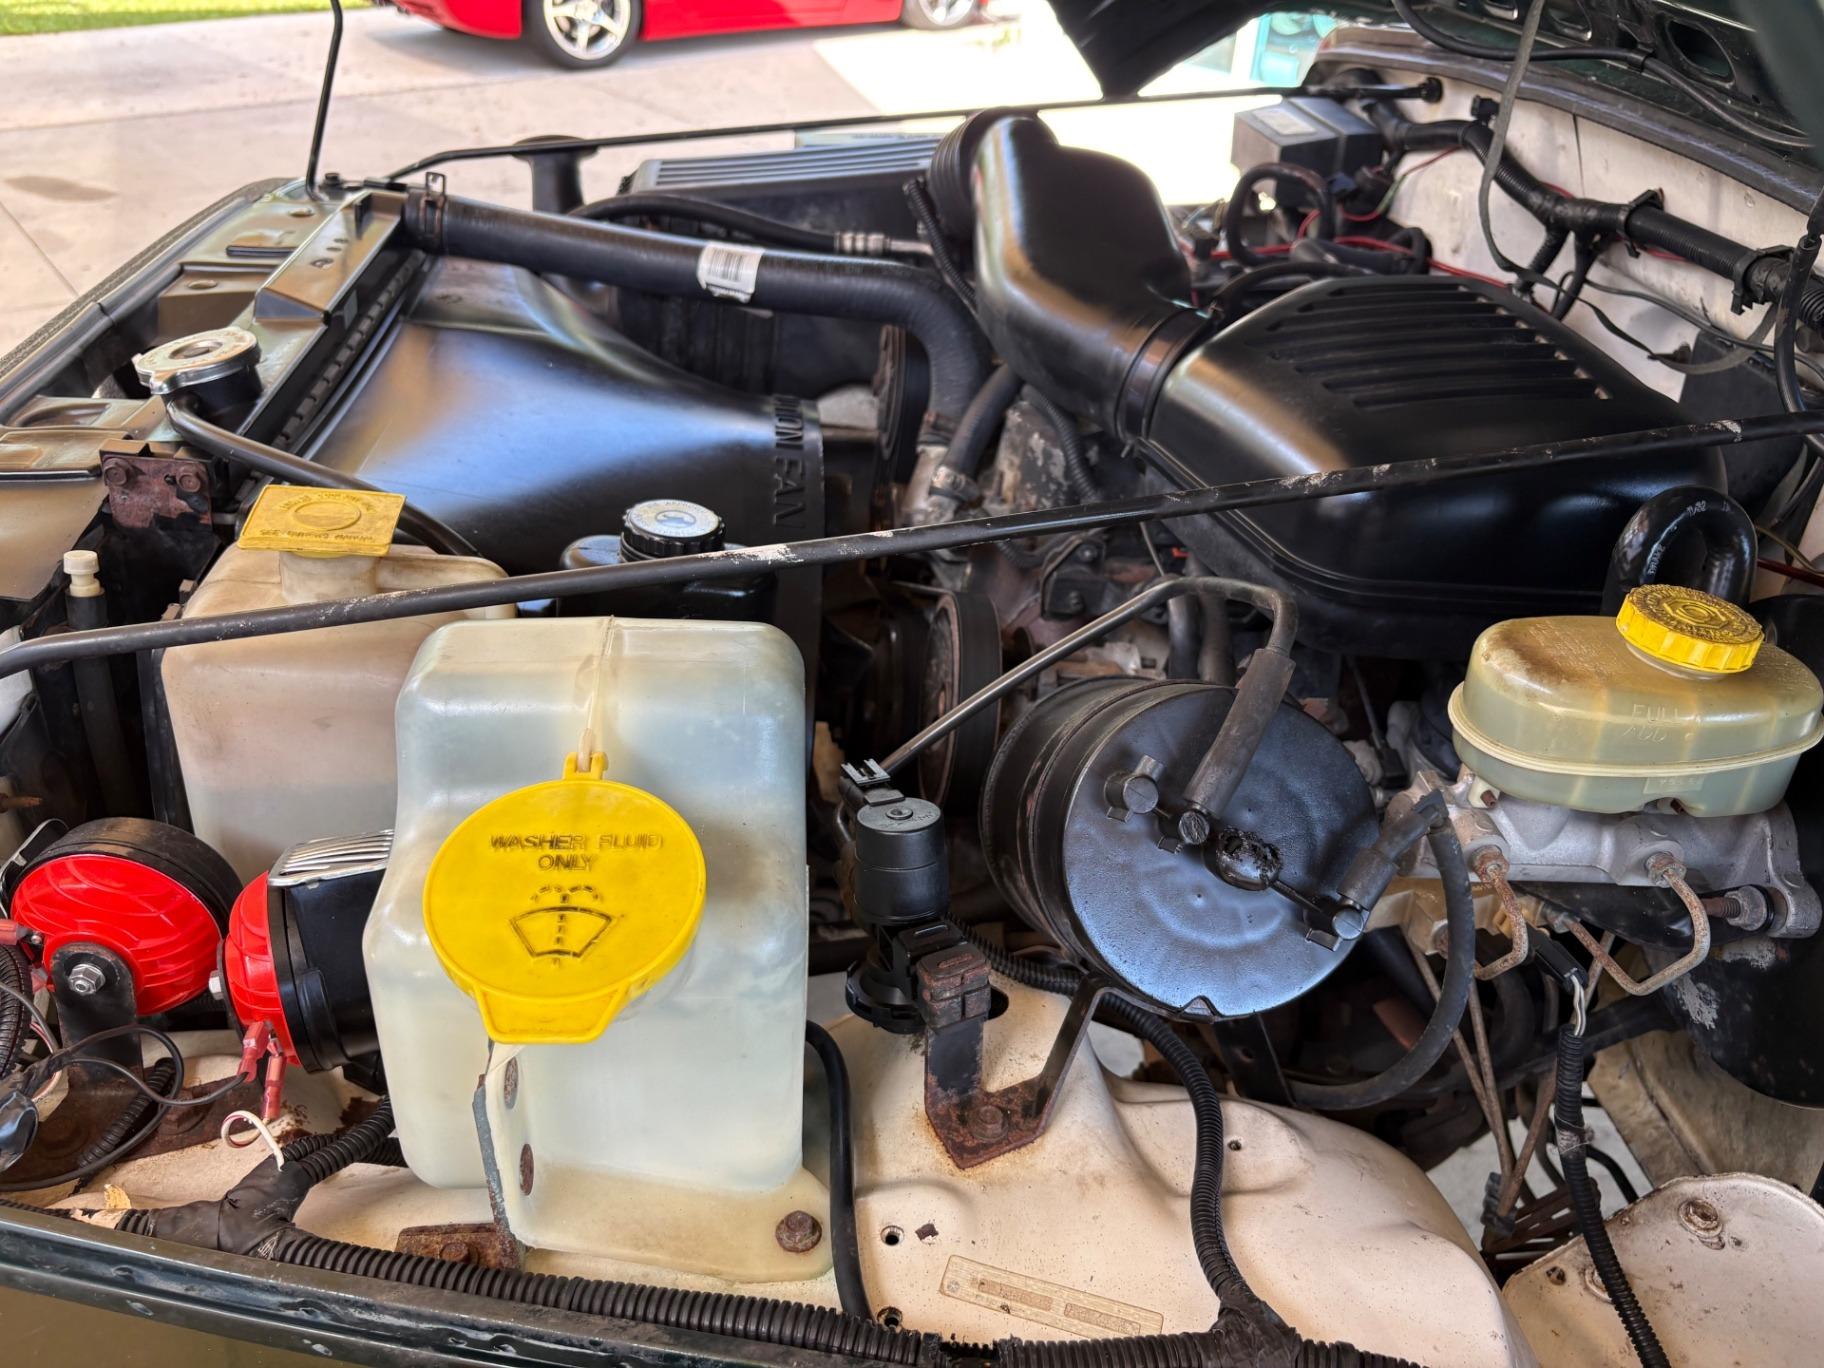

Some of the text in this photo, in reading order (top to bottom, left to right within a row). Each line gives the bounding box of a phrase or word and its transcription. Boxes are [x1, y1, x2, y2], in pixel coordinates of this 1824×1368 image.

[772, 456, 807, 528] FAN
[1632, 703, 1682, 725] FULL
[490, 833, 664, 850] WASHER FLUID
[537, 854, 595, 871] ONLY
